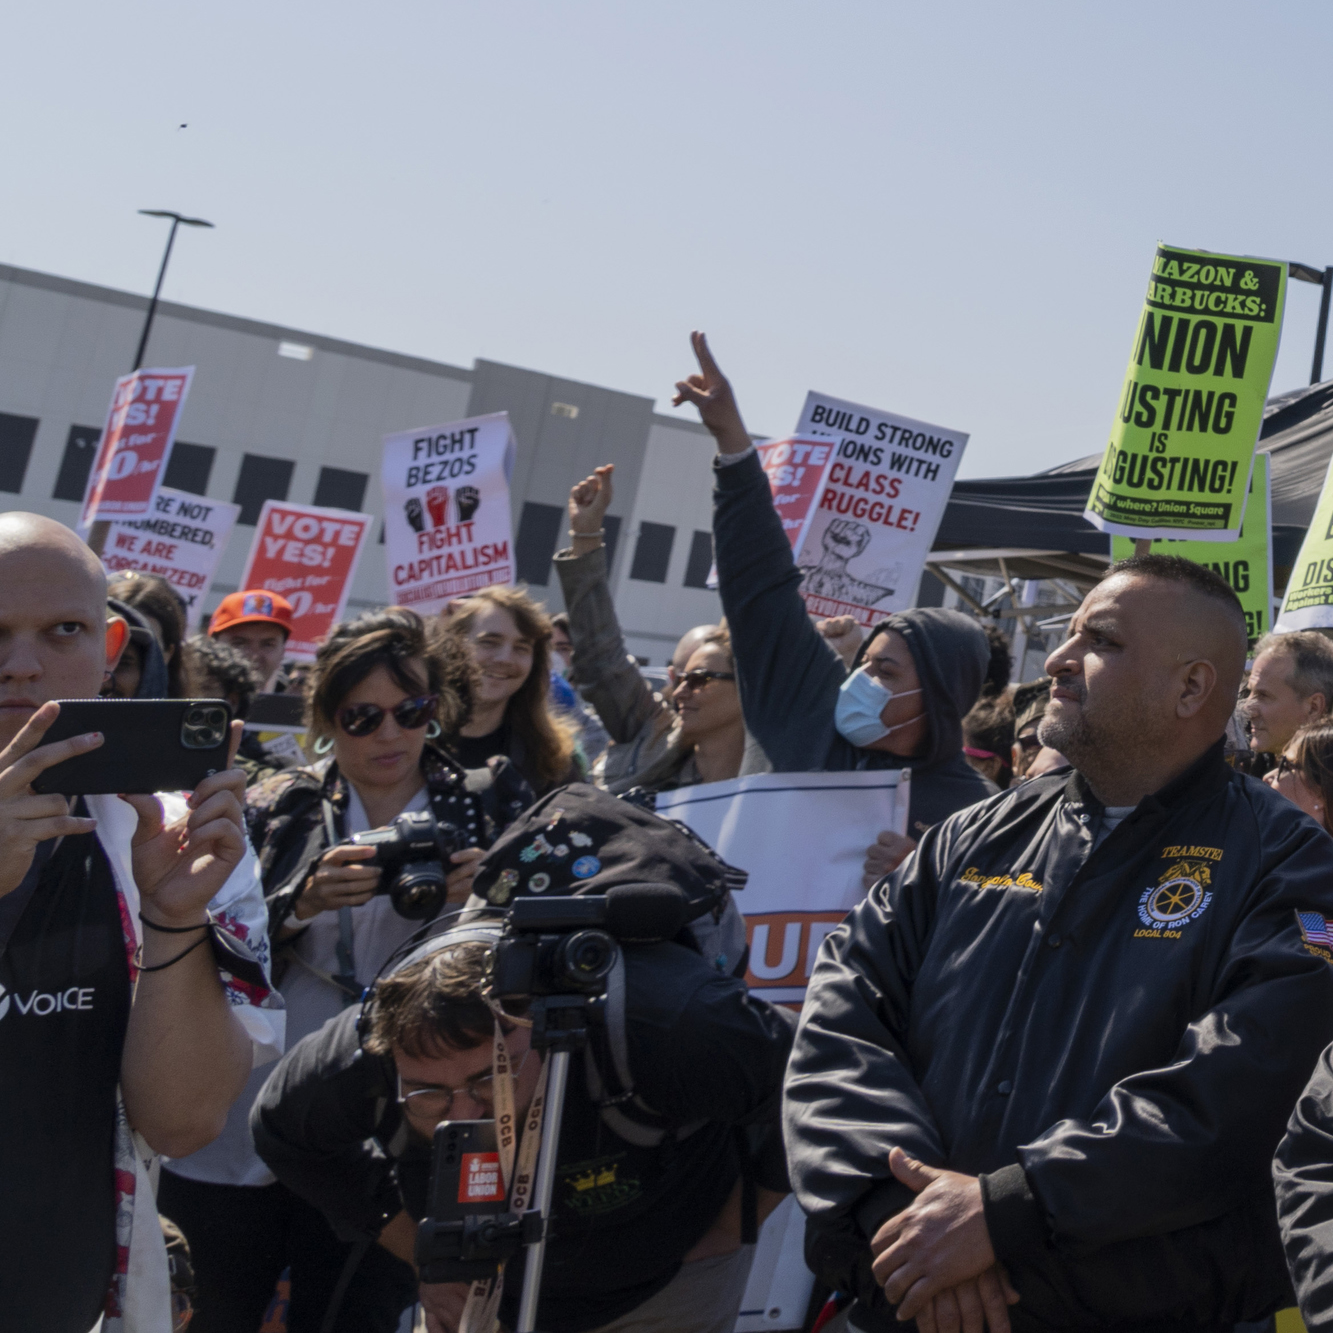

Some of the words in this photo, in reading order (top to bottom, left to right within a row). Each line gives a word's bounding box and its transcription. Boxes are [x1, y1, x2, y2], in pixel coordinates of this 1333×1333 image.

[1152, 255, 1236, 287] MAZON
[1239, 270, 1259, 290] &
[1147, 280, 1267, 317] ARBUCKS:
[1134, 309, 1253, 379] NION
[1120, 380, 1238, 435] USTING
[412, 427, 479, 461] FIGHT
[810, 404, 870, 436] BUILD
[874, 422, 954, 459] STRONG
[1149, 431, 1168, 454] IS
[406, 454, 479, 488] BEZOS
[768, 466, 806, 487] ES!
[828, 462, 902, 499] CLASS
[890, 452, 940, 482] WITH
[155, 495, 171, 514] RE
[177, 500, 214, 522] NOT
[820, 490, 921, 532] RUGGLE!
[1117, 499, 1157, 512] where?
[1158, 502, 1187, 513] Union
[1189, 504, 1224, 516] Square
[271, 512, 360, 546] VOTE
[417, 521, 475, 554] FIGHT
[115, 532, 137, 552] WE
[141, 537, 178, 561] ARE
[264, 536, 335, 568] YES!
[393, 541, 509, 586] CAPITALISM
[1286, 596, 1325, 611] Against
[1290, 586, 1332, 601] Workers
[1161, 845, 1223, 861] TEAMSTE
[1139, 887, 1154, 904] THE
[1191, 891, 1214, 919] CAREY
[1137, 906, 1154, 926] HOME
[1152, 921, 1166, 929] OF
[1168, 916, 1190, 929] RON
[1133, 929, 1161, 938] LOCAL
[1163, 930, 1182, 939] 804
[14, 987, 95, 1015] VOICE
[501, 1114, 512, 1148] OCB
[467, 1184, 497, 1196] UNION
[468, 1172, 498, 1184] LABOR
[514, 1174, 529, 1209] OCB
